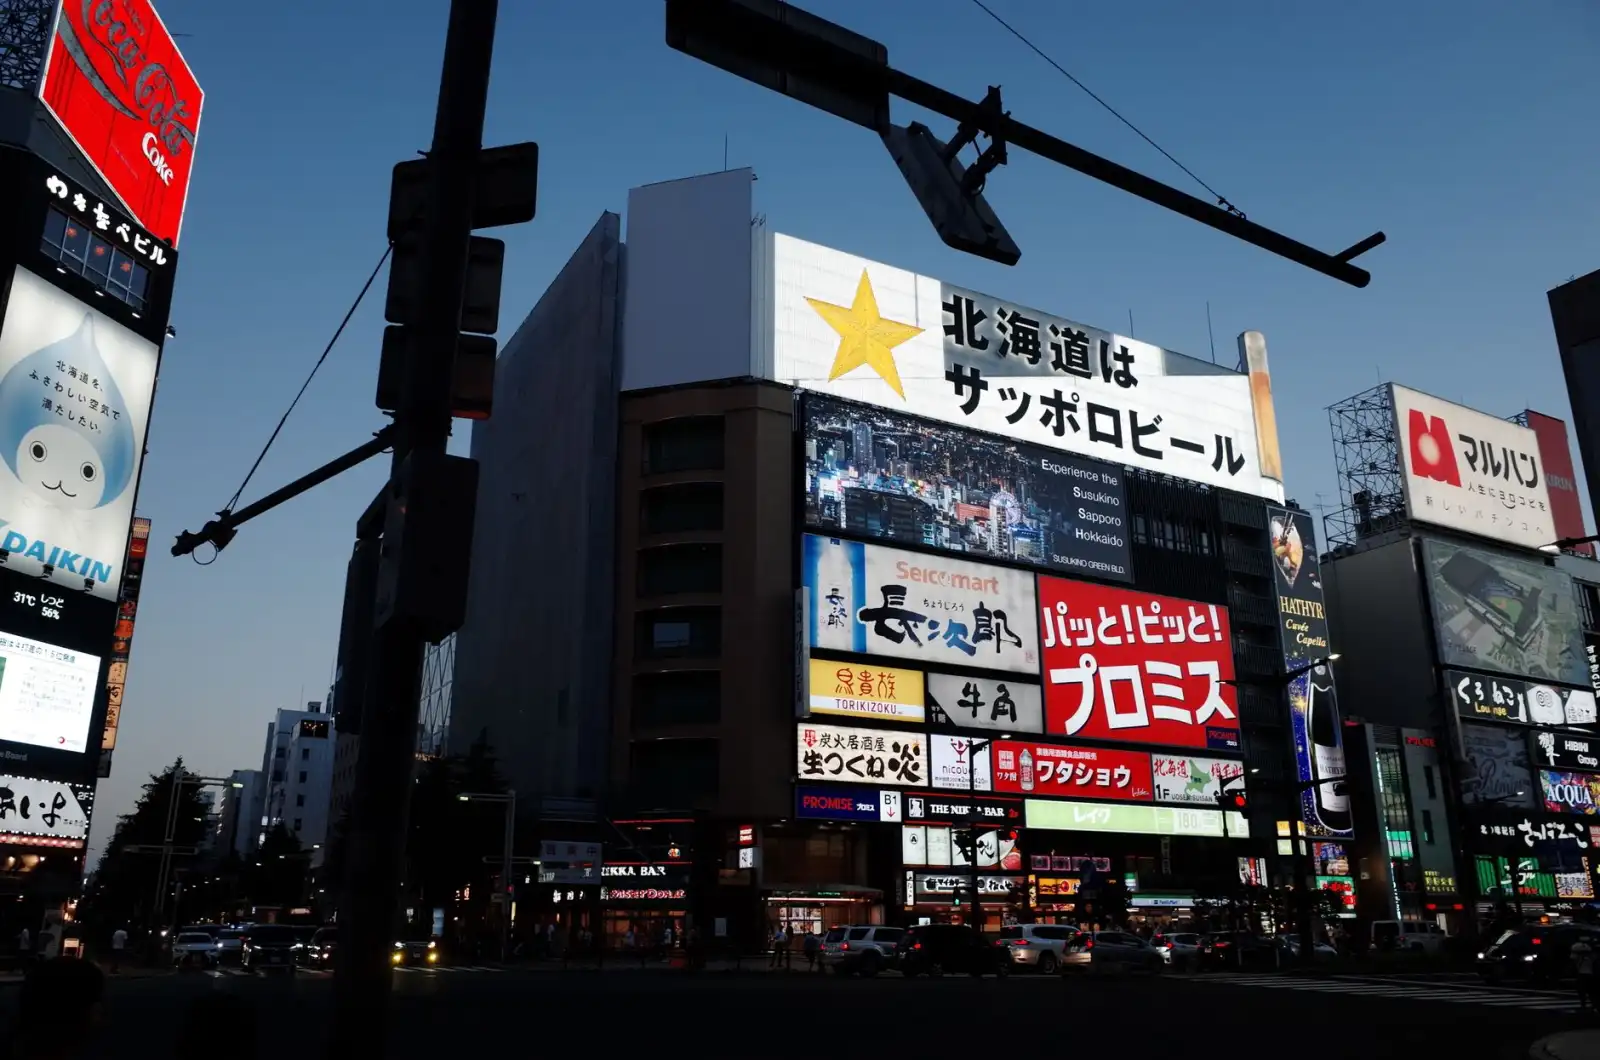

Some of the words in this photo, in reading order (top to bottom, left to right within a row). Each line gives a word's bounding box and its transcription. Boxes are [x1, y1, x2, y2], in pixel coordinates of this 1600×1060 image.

[142, 132, 173, 185] Coke
[942, 295, 1138, 389] 北海道は
[29, 370, 120, 420] ふさわしい空気で
[42, 397, 101, 434] 満たしたい。
[945, 362, 1246, 477] サッポロビール
[1458, 434, 1538, 488] マルハン
[1041, 459, 1098, 481] Experience
[1101, 473, 1118, 486] the
[1073, 486, 1120, 506] Susukino
[1078, 508, 1122, 527] Sapporo
[1075, 528, 1124, 547] Hokkaido
[2, 530, 112, 583] DAIKIN
[1053, 554, 1088, 568] SUSUKINO
[1088, 561, 1111, 572] GREEN
[896, 561, 1000, 595] Seicomart
[42, 606, 60, 620] 56%
[922, 598, 965, 613] ちょうじろう
[1280, 596, 1324, 619] HATHYR
[856, 584, 1023, 658] 長次郎
[1296, 633, 1327, 647] Capella
[1050, 653, 1237, 735] プロミス
[1457, 676, 1514, 706] くろねこ
[836, 698, 897, 715] TORIKIZOKU
[957, 681, 1018, 723] 牛角
[1474, 702, 1507, 716] Lounge
[819, 734, 886, 752] 炭火居酒屋
[1153, 757, 1189, 779] 北海道
[1577, 754, 1598, 767] Group
[1036, 760, 1131, 788] ワタショウ
[884, 794, 897, 806] B1
[1155, 784, 1170, 801] 1F
[1547, 783, 1592, 807] ACQUA
[803, 796, 854, 811] PROMISE
[929, 804, 950, 815] THE
[984, 806, 1005, 817] BAR
[1073, 806, 1112, 824] レイク
[640, 867, 666, 876] BAR
